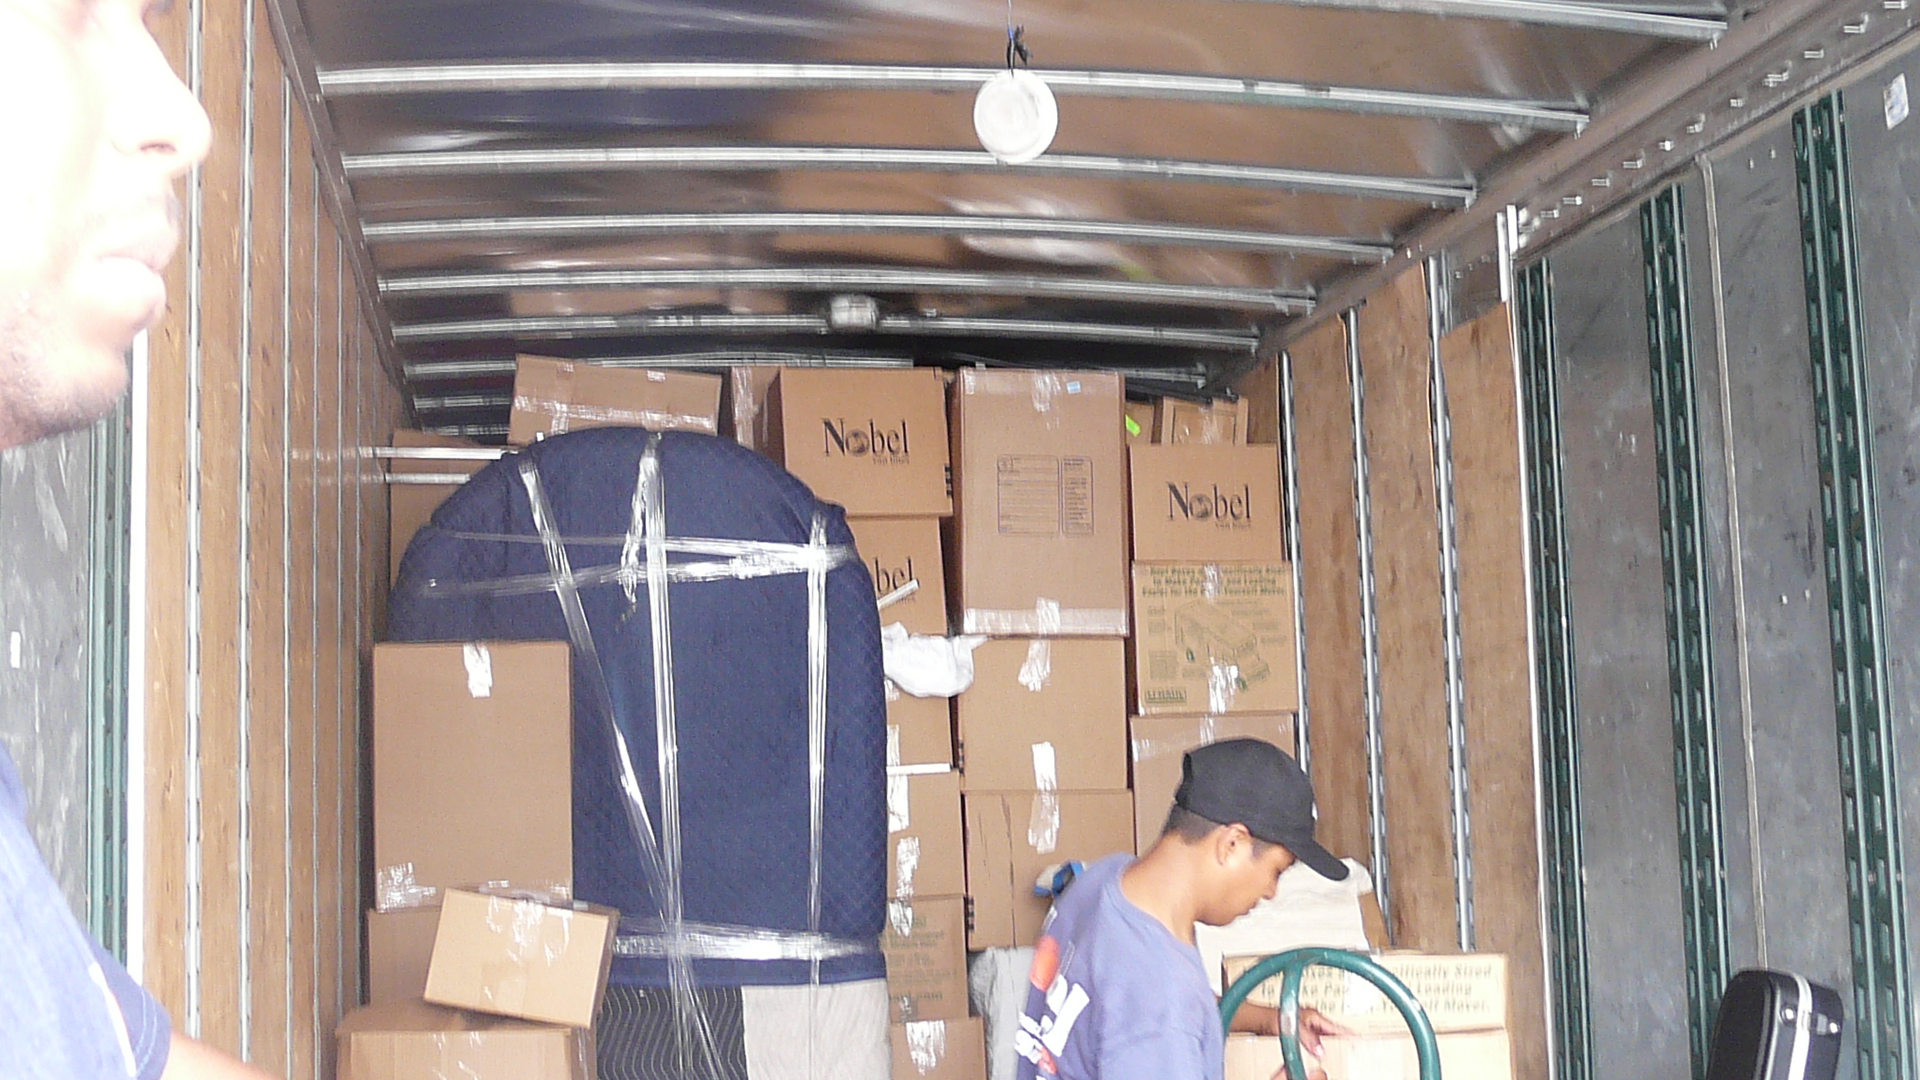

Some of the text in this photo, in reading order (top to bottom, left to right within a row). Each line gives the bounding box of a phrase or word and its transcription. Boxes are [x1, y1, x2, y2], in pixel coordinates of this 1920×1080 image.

[820, 417, 909, 456] Nobel
[1166, 481, 1251, 521] Nobel
[873, 556, 913, 596] bel
